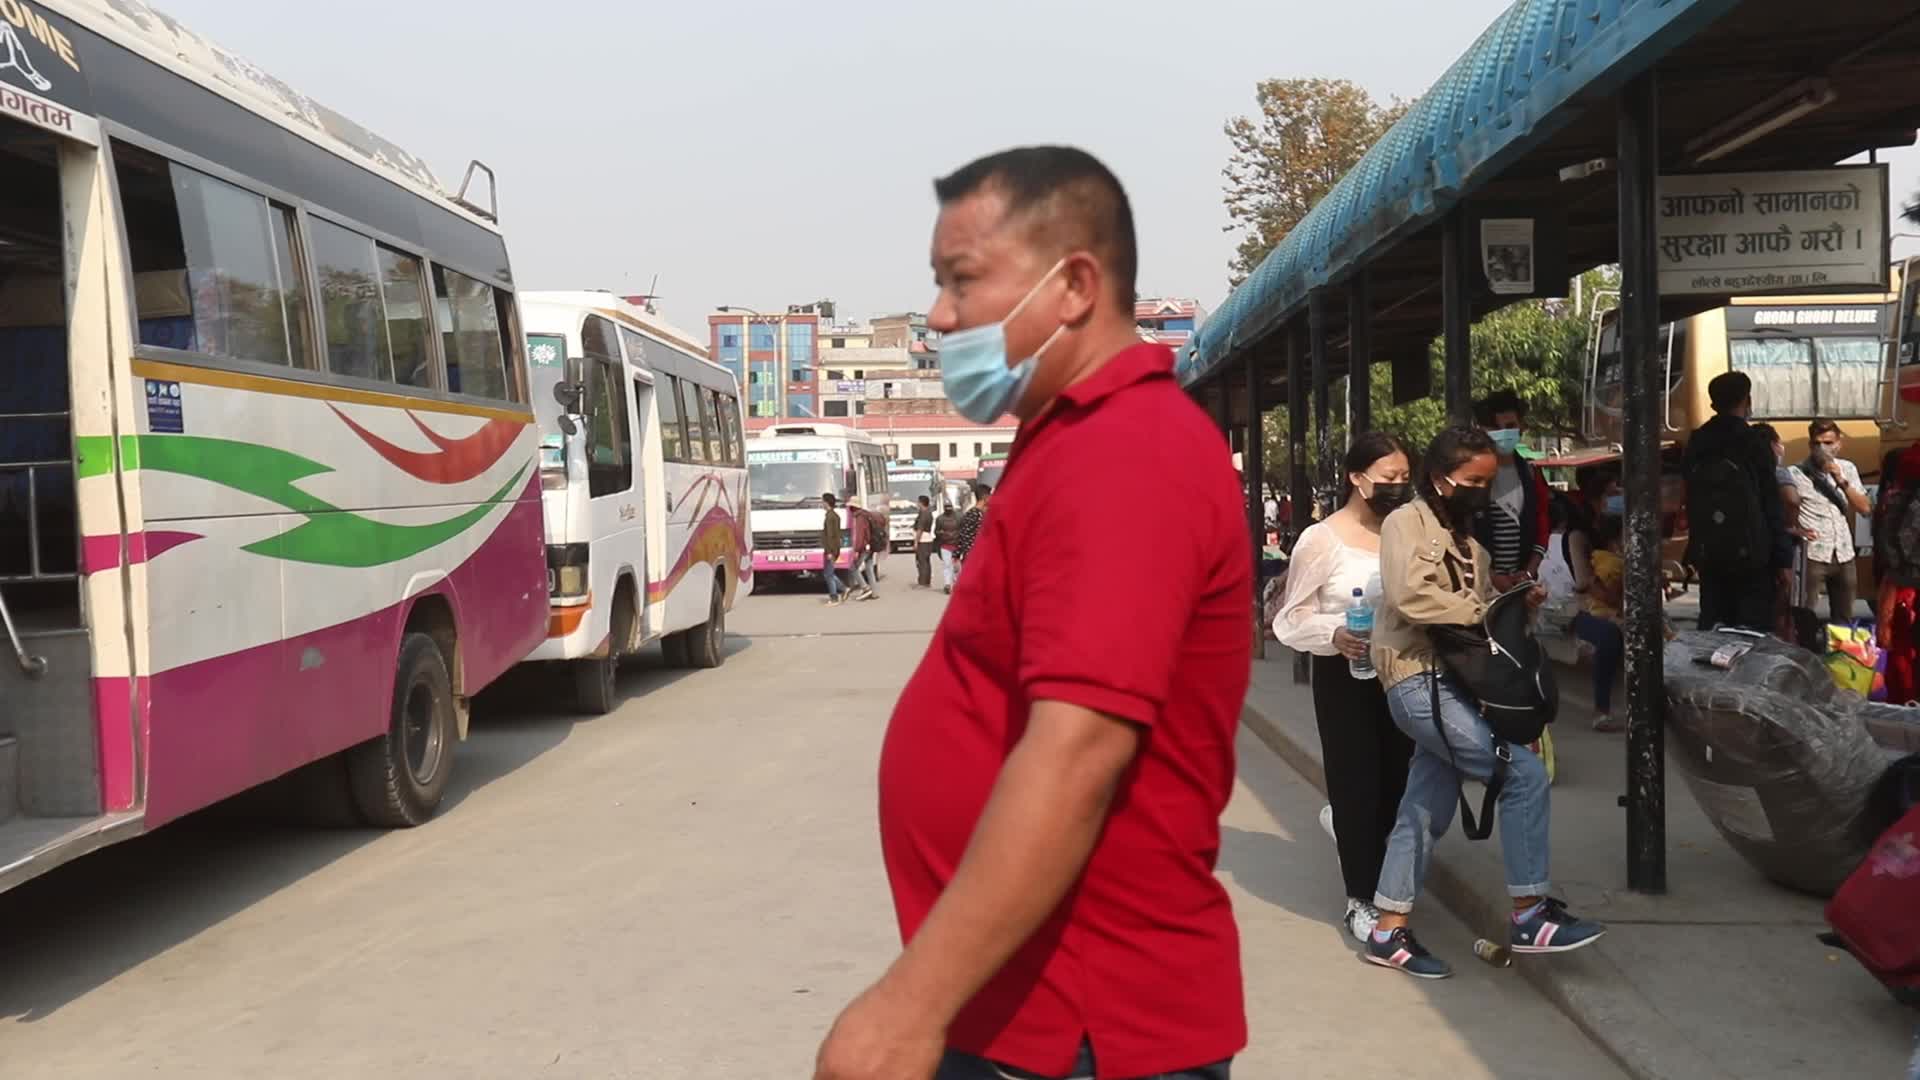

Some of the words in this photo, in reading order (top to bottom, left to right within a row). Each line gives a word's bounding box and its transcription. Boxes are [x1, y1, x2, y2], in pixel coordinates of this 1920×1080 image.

[1752, 183, 1861, 216] सामानको
[1660, 233, 1728, 263] सुरक्षा
[1834, 309, 1878, 324] DELUXE
